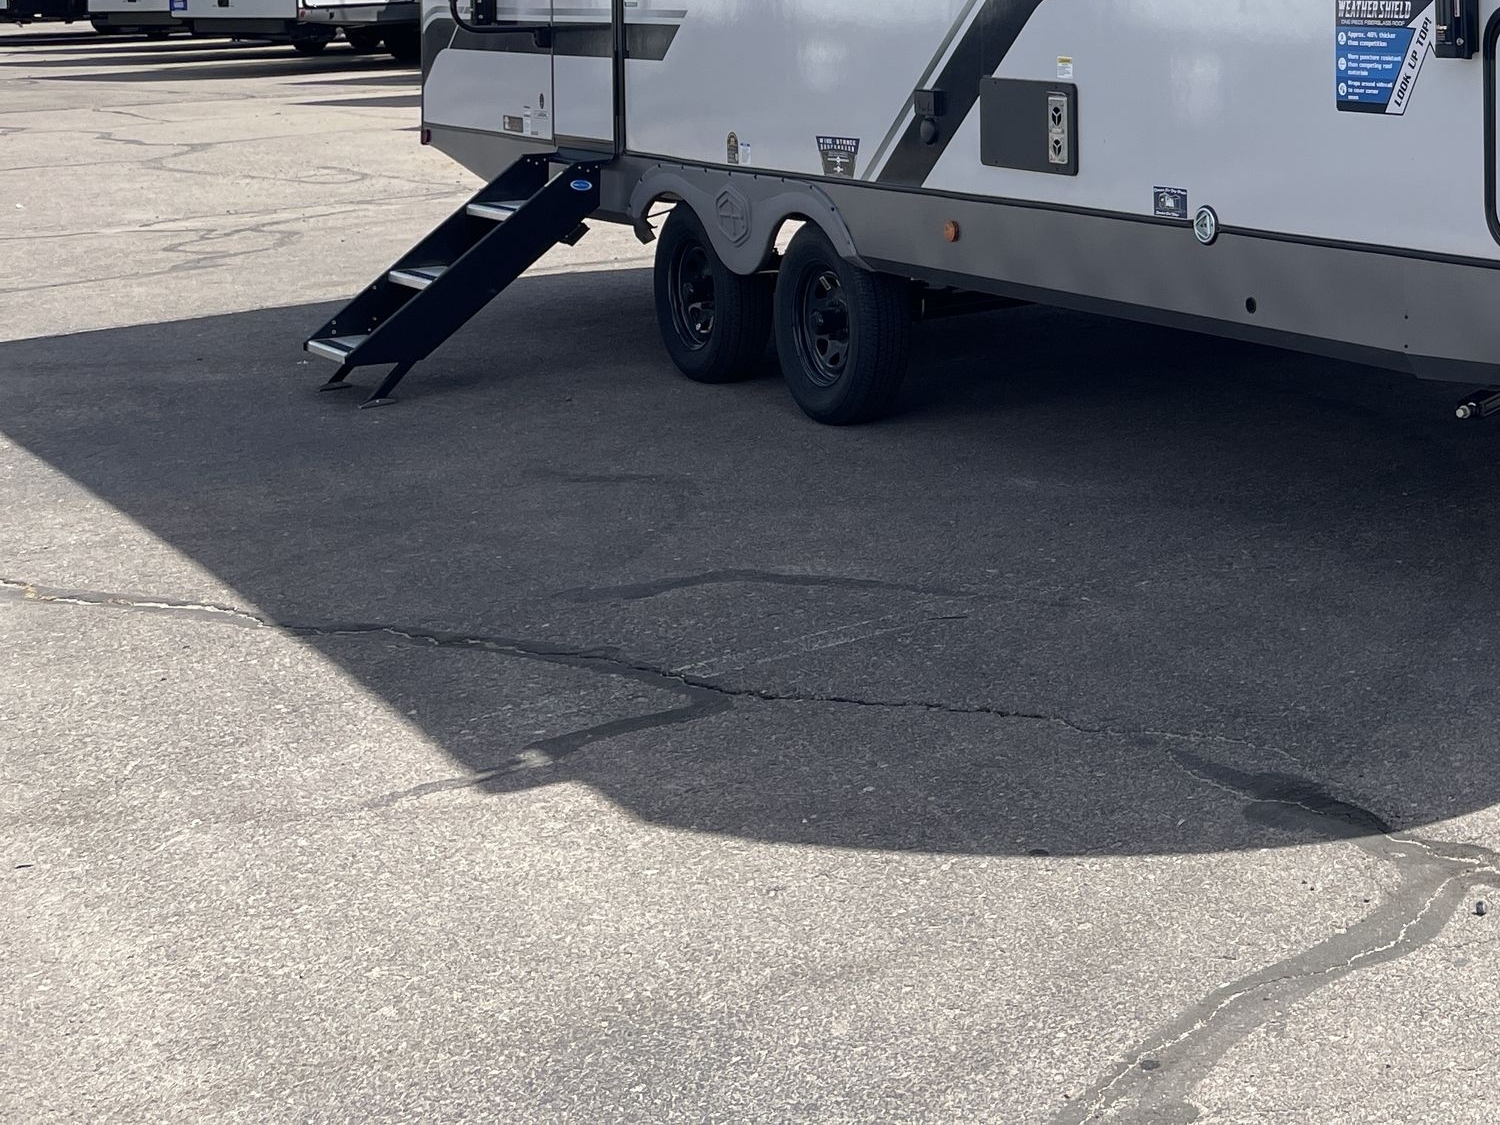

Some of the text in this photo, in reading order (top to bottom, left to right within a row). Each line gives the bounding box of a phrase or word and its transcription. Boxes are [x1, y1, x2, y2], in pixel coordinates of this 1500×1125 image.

[1394, 16, 1432, 107] LOOK UP TOP!
